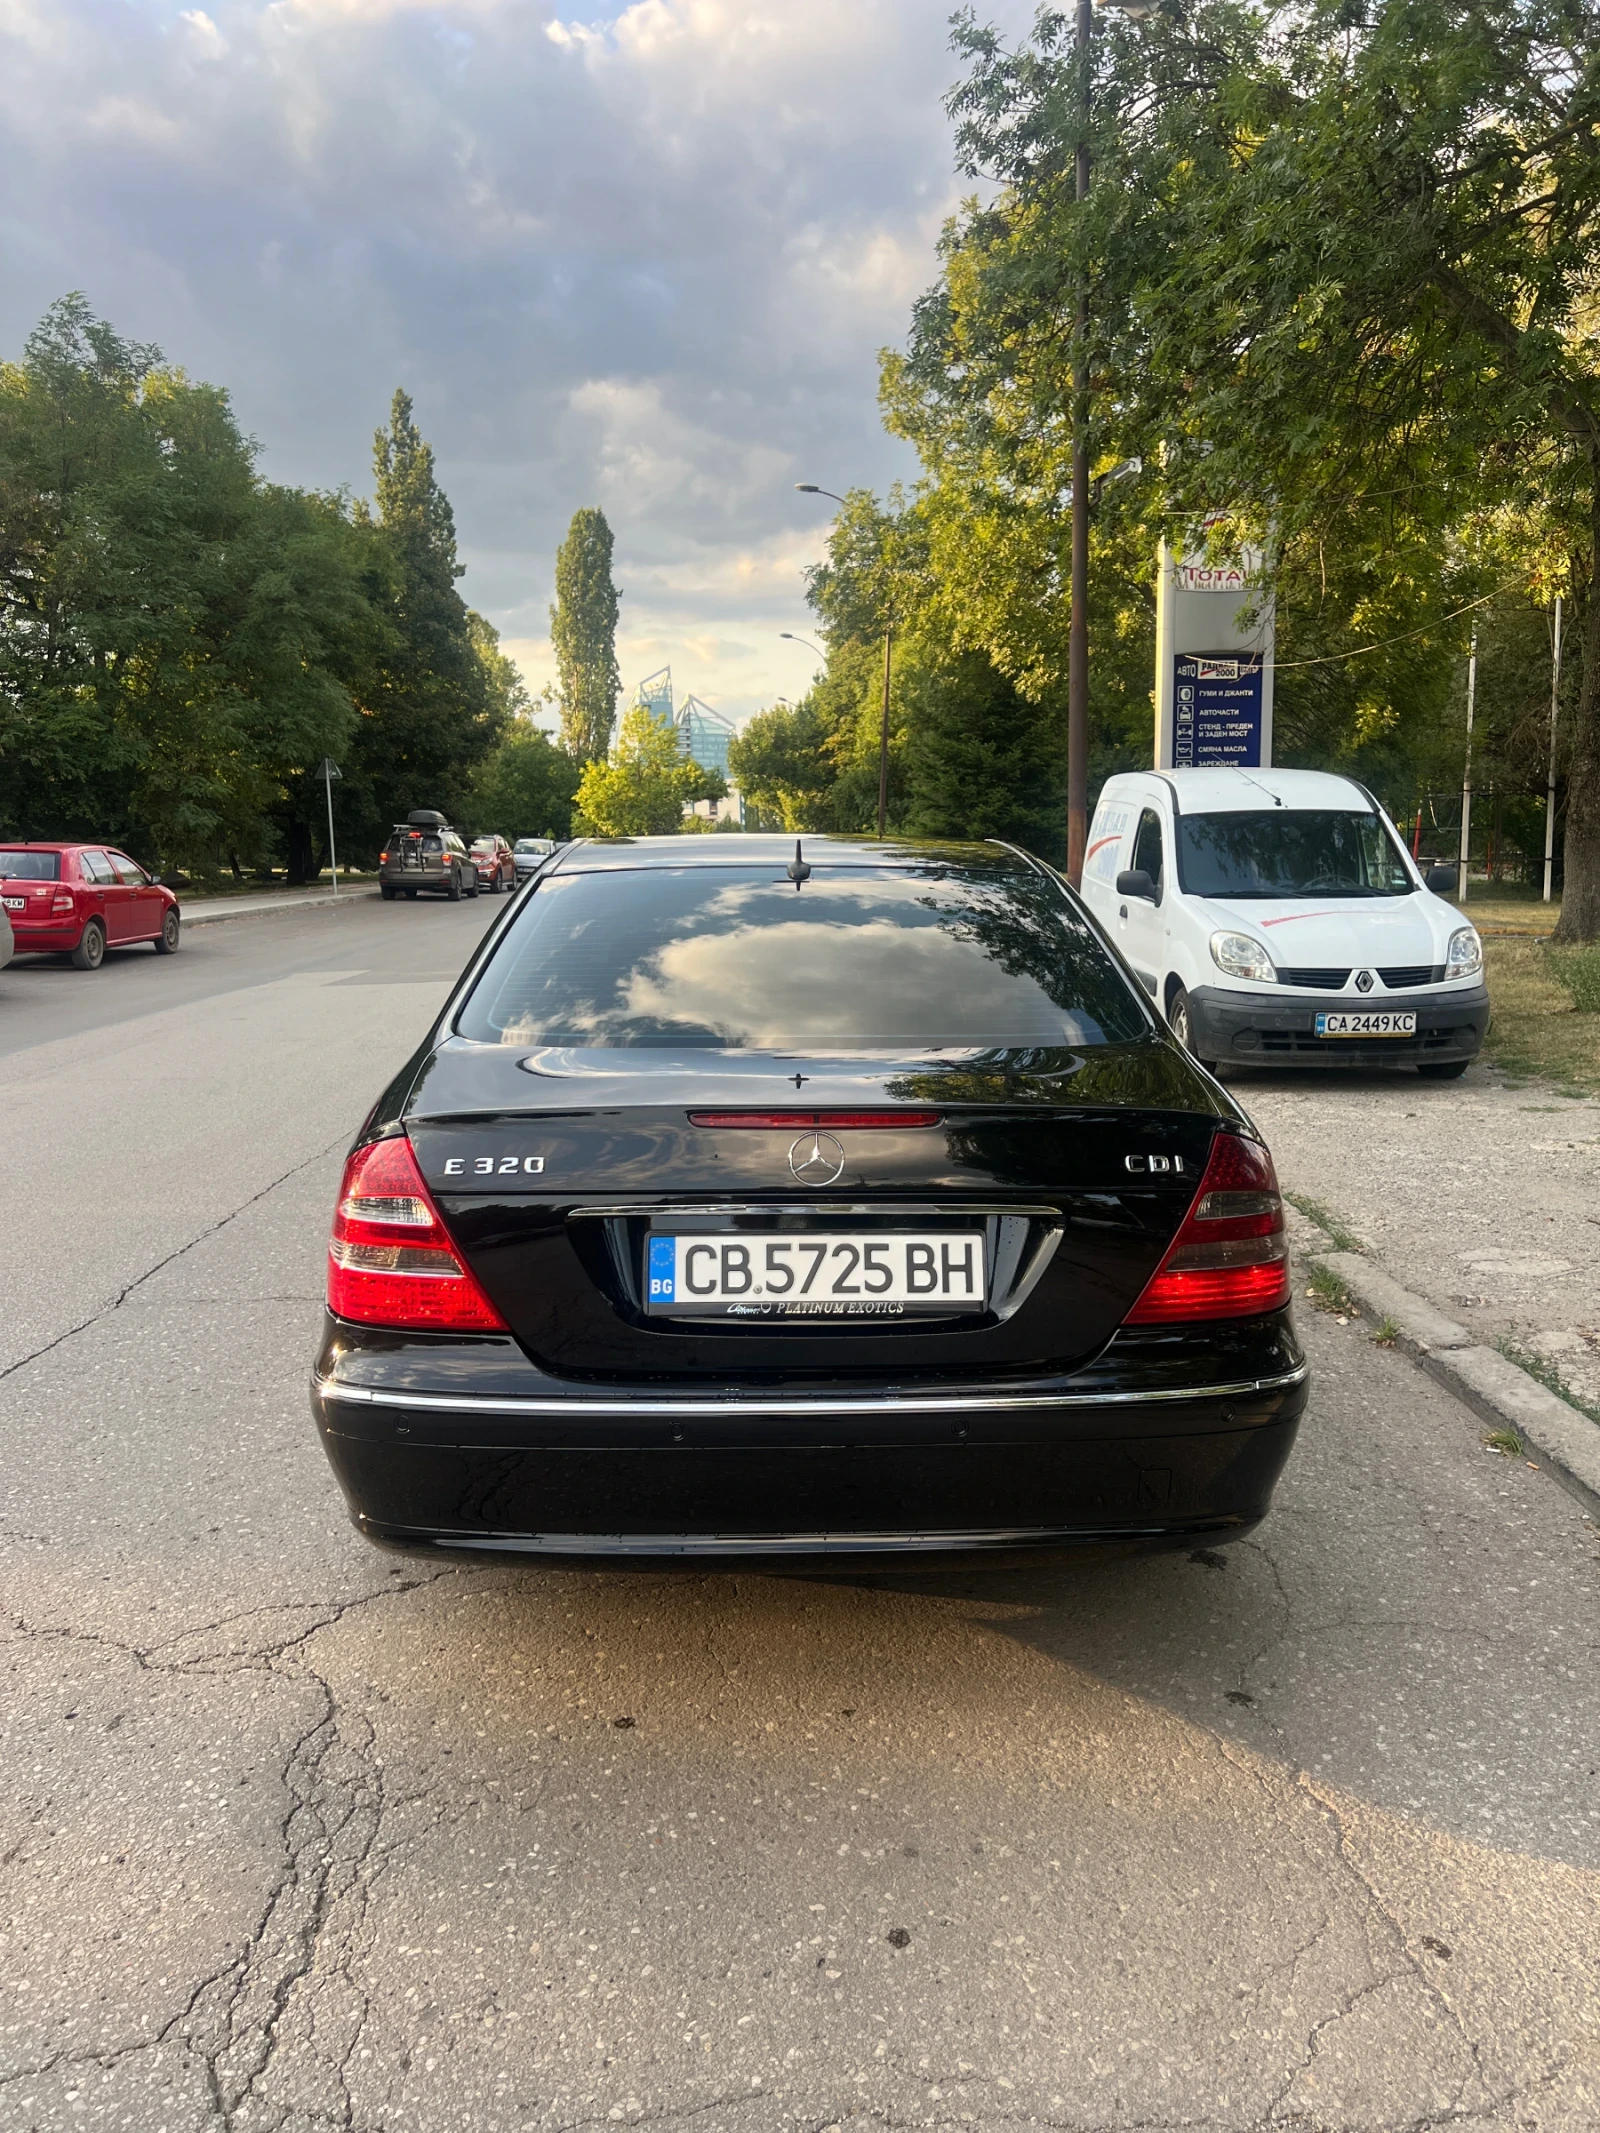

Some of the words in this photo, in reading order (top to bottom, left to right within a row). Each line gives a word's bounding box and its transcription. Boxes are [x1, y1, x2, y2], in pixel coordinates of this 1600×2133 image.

[1177, 664, 1196, 677] АВТО
[1215, 669, 1236, 677] 2000
[1224, 689, 1254, 697] ДЖАНТИ
[1327, 1016, 1348, 1032] CA
[1351, 1016, 1390, 1032] 2449
[1392, 1015, 1414, 1031] KC
[444, 1158, 465, 1175] E
[473, 1156, 545, 1174] 320
[1124, 1154, 1184, 1173] CDI
[685, 1243, 753, 1295] CB
[765, 1243, 894, 1294] 5725
[650, 1279, 674, 1294] BG
[776, 1302, 844, 1314] PLATINUM
[847, 1302, 905, 1314] EXOTICS
